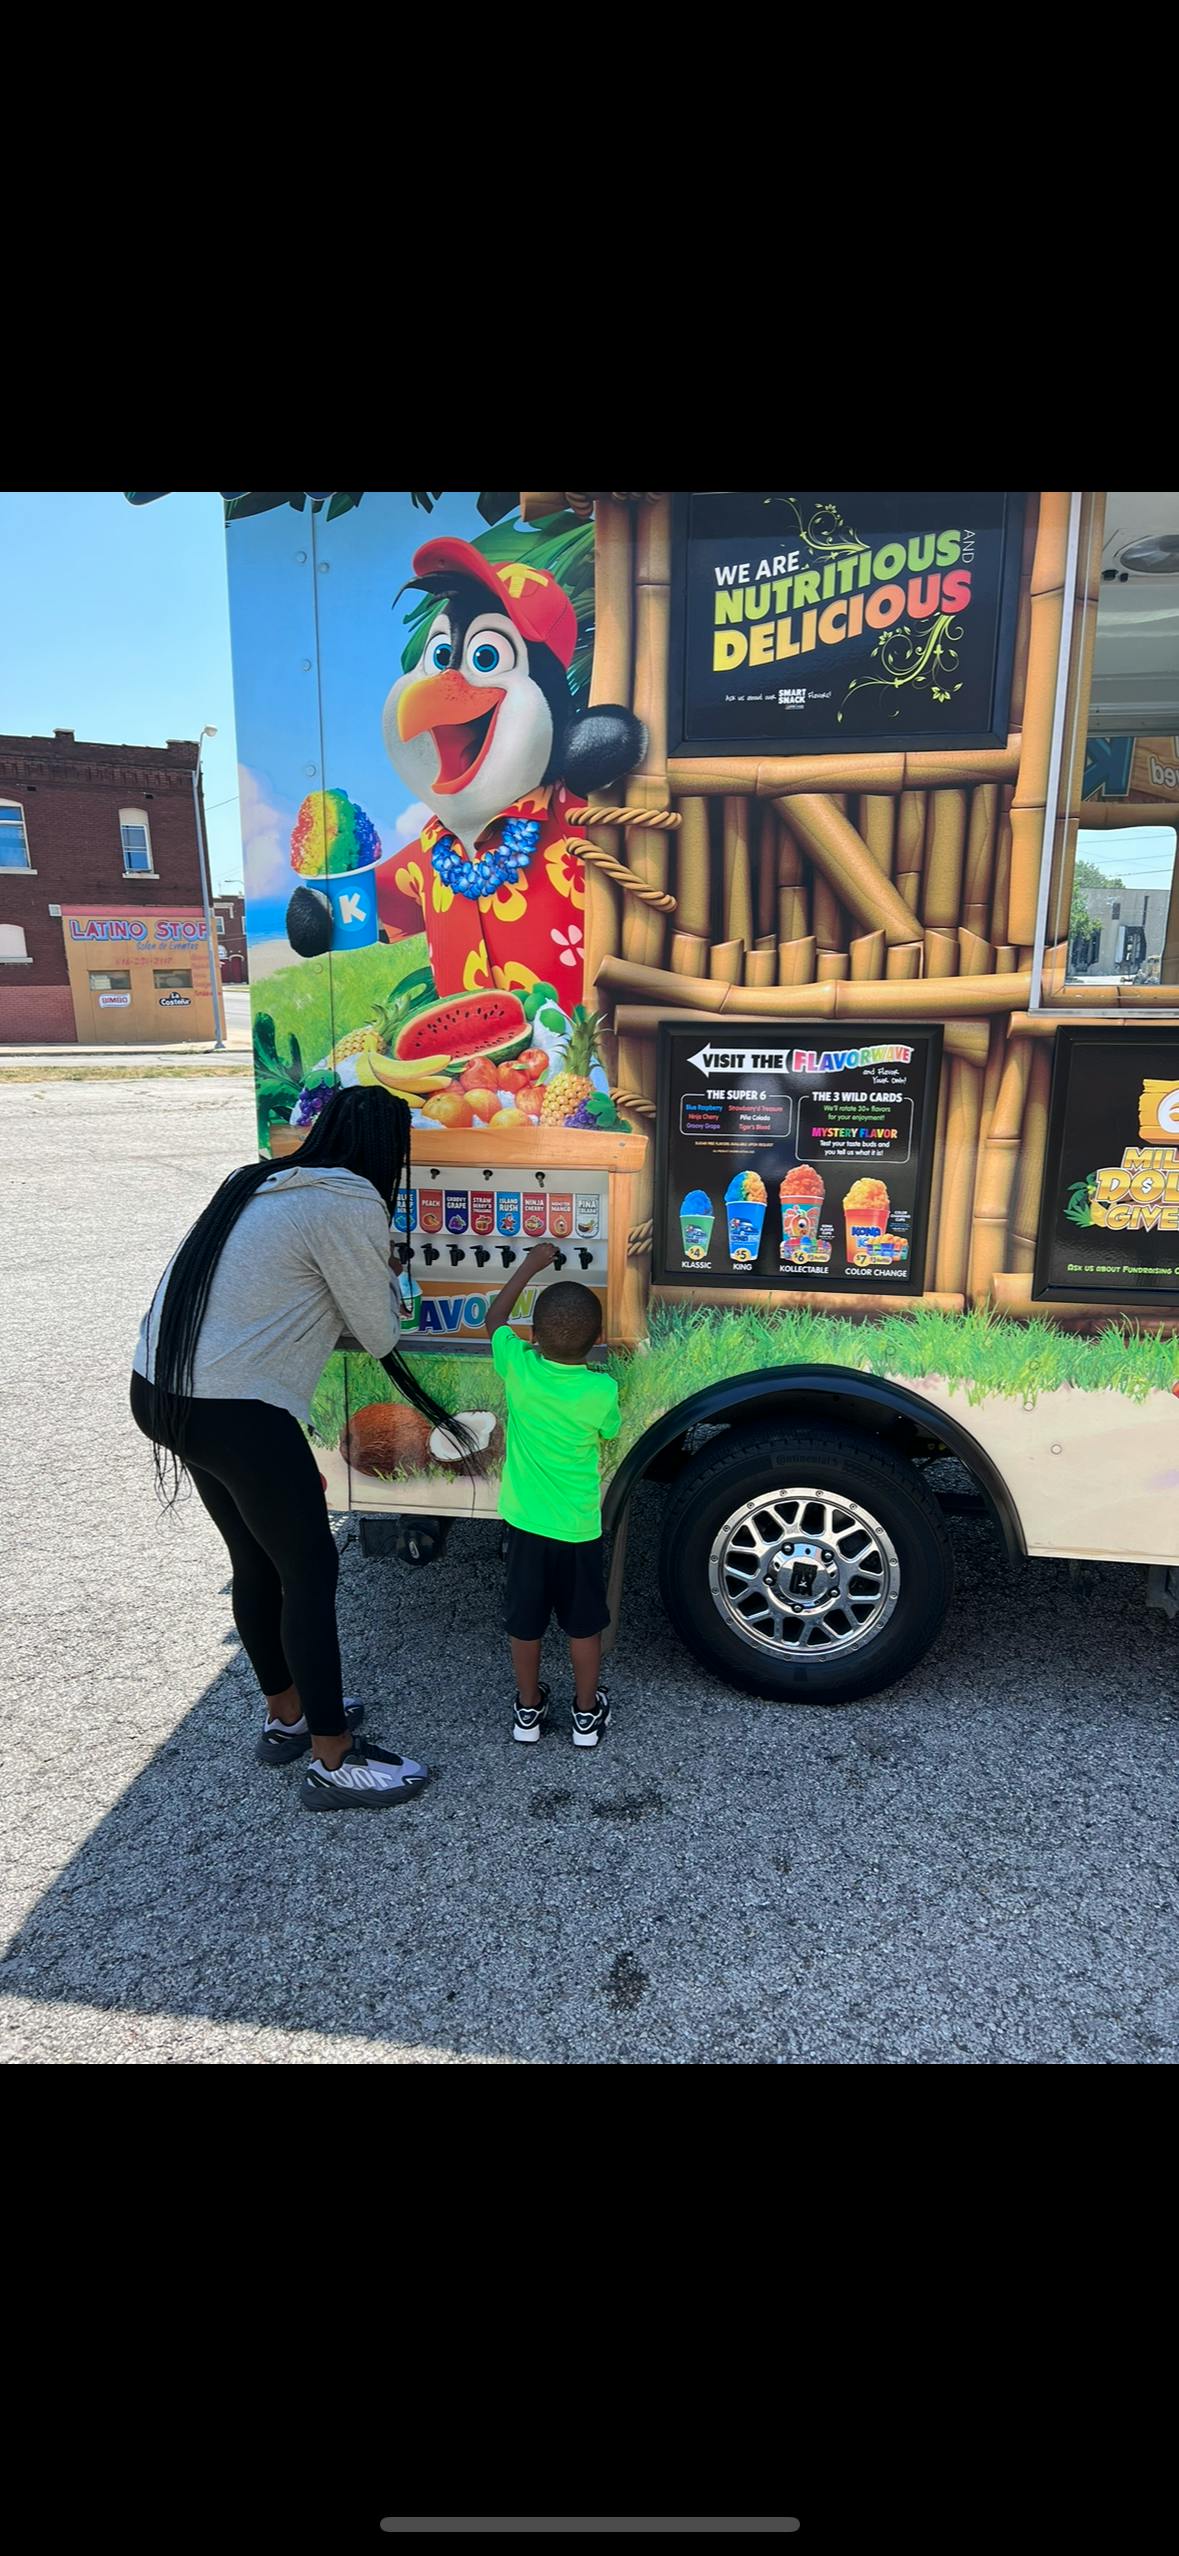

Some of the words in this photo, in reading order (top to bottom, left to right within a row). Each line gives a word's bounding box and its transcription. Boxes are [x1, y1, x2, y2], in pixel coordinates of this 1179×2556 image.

[961, 529, 976, 564] AND
[714, 563, 750, 586] WE
[755, 550, 800, 580] ARE
[714, 529, 961, 625] NUTRITIOUS
[712, 569, 972, 672] DELICIOUS
[778, 688, 806, 696] SMART
[778, 696, 806, 704] SNACK
[338, 892, 367, 924] K
[69, 919, 148, 942] LATINO
[703, 1053, 745, 1068] VISIT
[752, 1054, 782, 1068] THE
[792, 1044, 912, 1073] FLAVORWAVE
[706, 1090, 725, 1100] THE
[726, 1090, 757, 1100] SUPER
[759, 1090, 767, 1100] 6
[812, 1091, 831, 1101] THE
[832, 1092, 840, 1102] 3
[841, 1092, 867, 1102] WILD
[869, 1092, 903, 1102] CARDS
[812, 1127, 858, 1138] MYSTERY
[859, 1128, 898, 1138] FLAVOR
[499, 1204, 518, 1212] RUSH
[690, 1248, 700, 1258] $4
[736, 1250, 746, 1259] $5
[794, 1253, 805, 1261] $6
[856, 1255, 867, 1264] $7
[682, 1261, 712, 1269] KLASSIC
[733, 1263, 752, 1271] KING
[779, 1265, 829, 1274] KOLLECTABLE
[845, 1268, 872, 1276] COLOR
[874, 1269, 907, 1277] CHANGE
